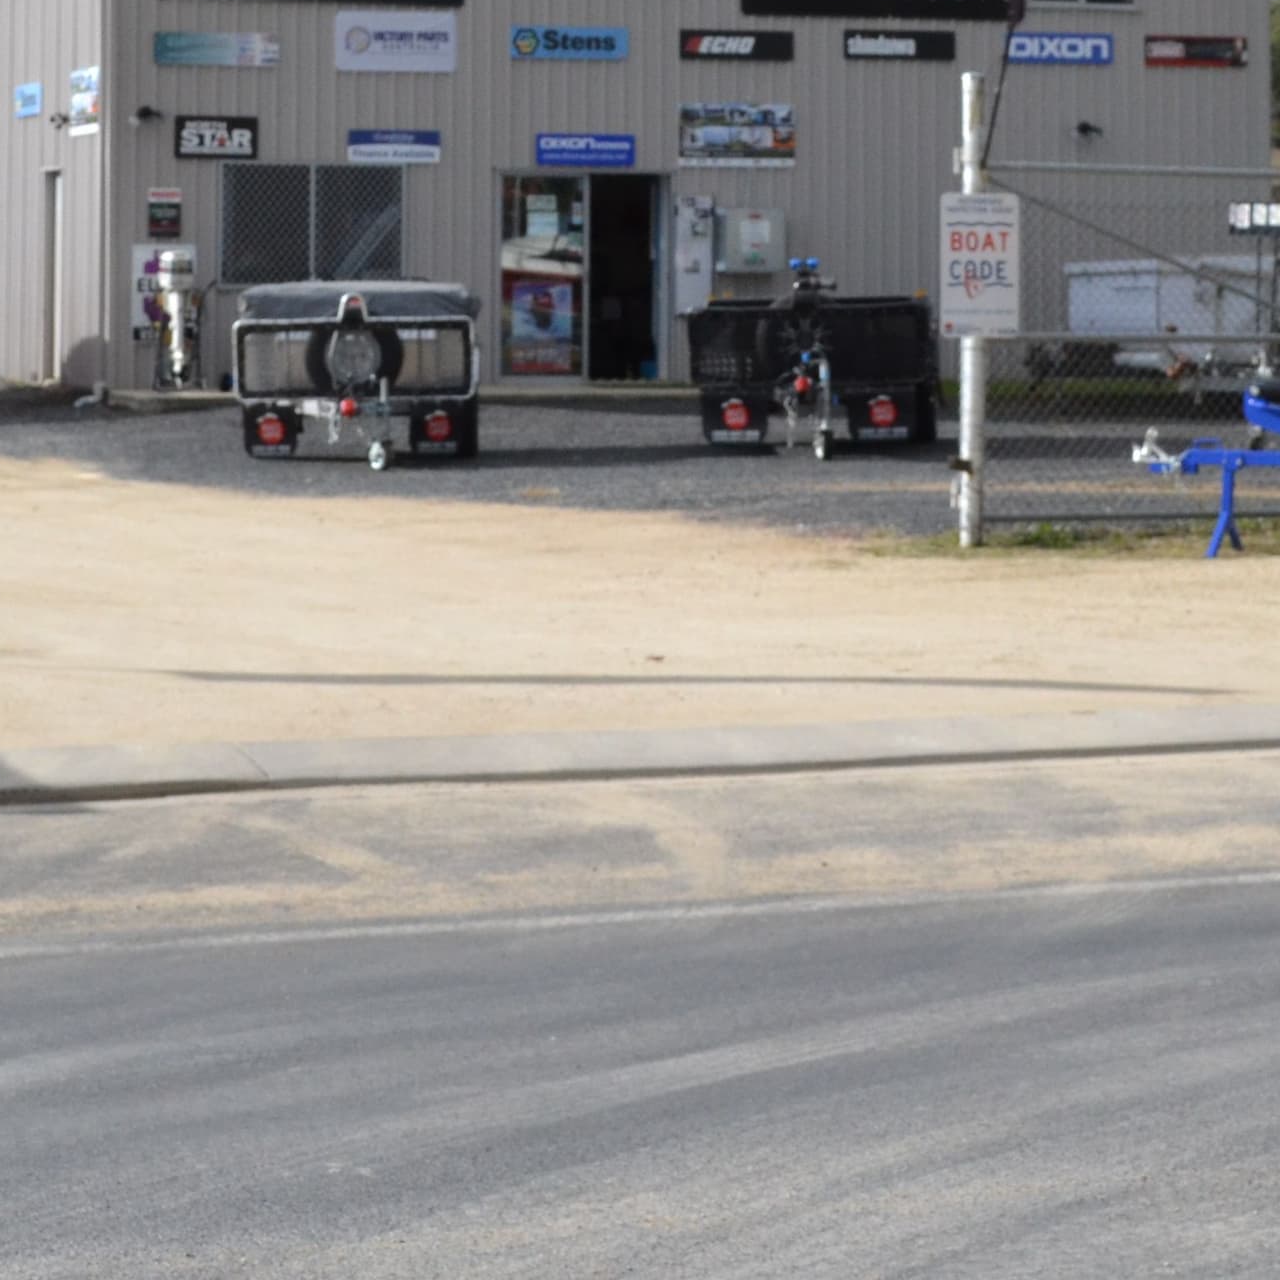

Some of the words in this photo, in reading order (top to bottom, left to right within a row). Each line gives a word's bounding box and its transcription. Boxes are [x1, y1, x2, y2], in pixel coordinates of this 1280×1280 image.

[542, 29, 616, 51] Stens
[699, 36, 756, 54] ECHO
[1008, 36, 1109, 60] DIXON
[180, 128, 252, 147] STAR
[950, 230, 1010, 252] BOAT
[949, 259, 1008, 281] CODE
